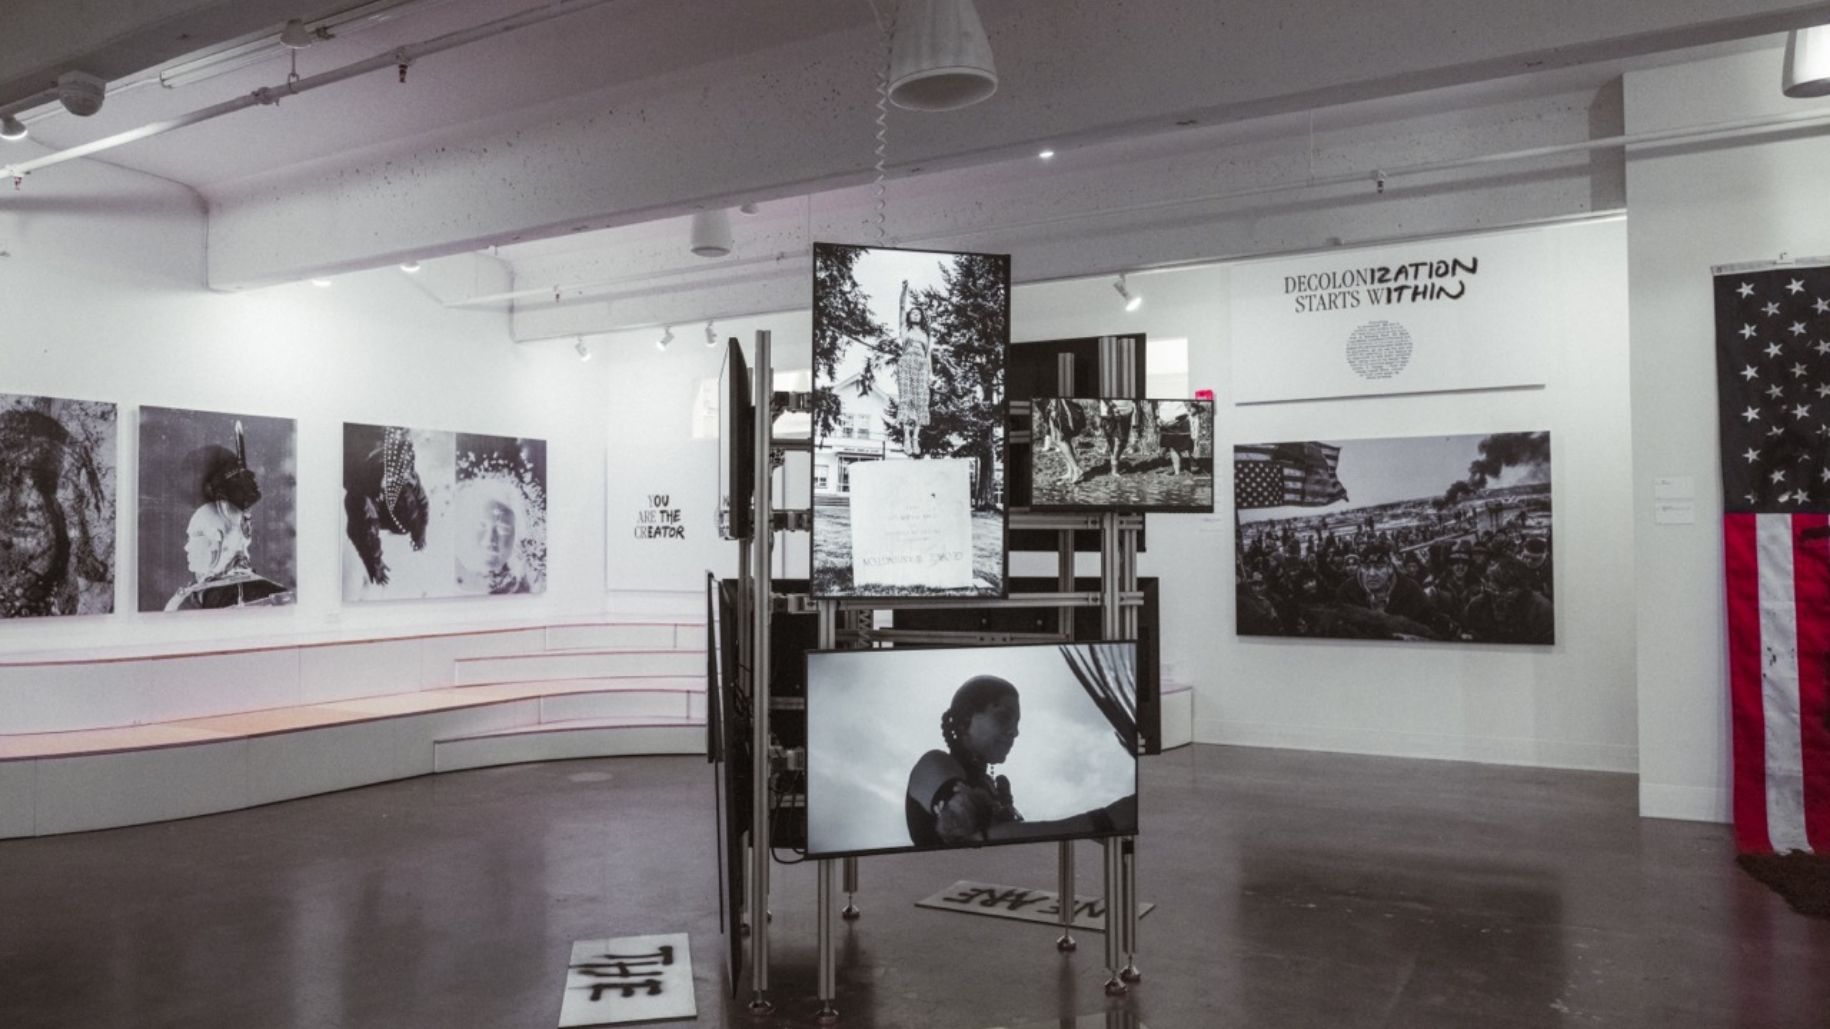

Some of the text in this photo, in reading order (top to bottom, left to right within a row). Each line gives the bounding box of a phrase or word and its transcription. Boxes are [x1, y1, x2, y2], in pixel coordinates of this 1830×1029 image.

[1284, 256, 1478, 294] DECOLONIZATION
[1294, 280, 1465, 313] STARTS WITHIN
[648, 494, 670, 508] YOU
[638, 509, 681, 524] ARE THE
[634, 525, 685, 539] CREATOR
[943, 888, 1050, 911] ARE
[568, 945, 674, 1001] THE
